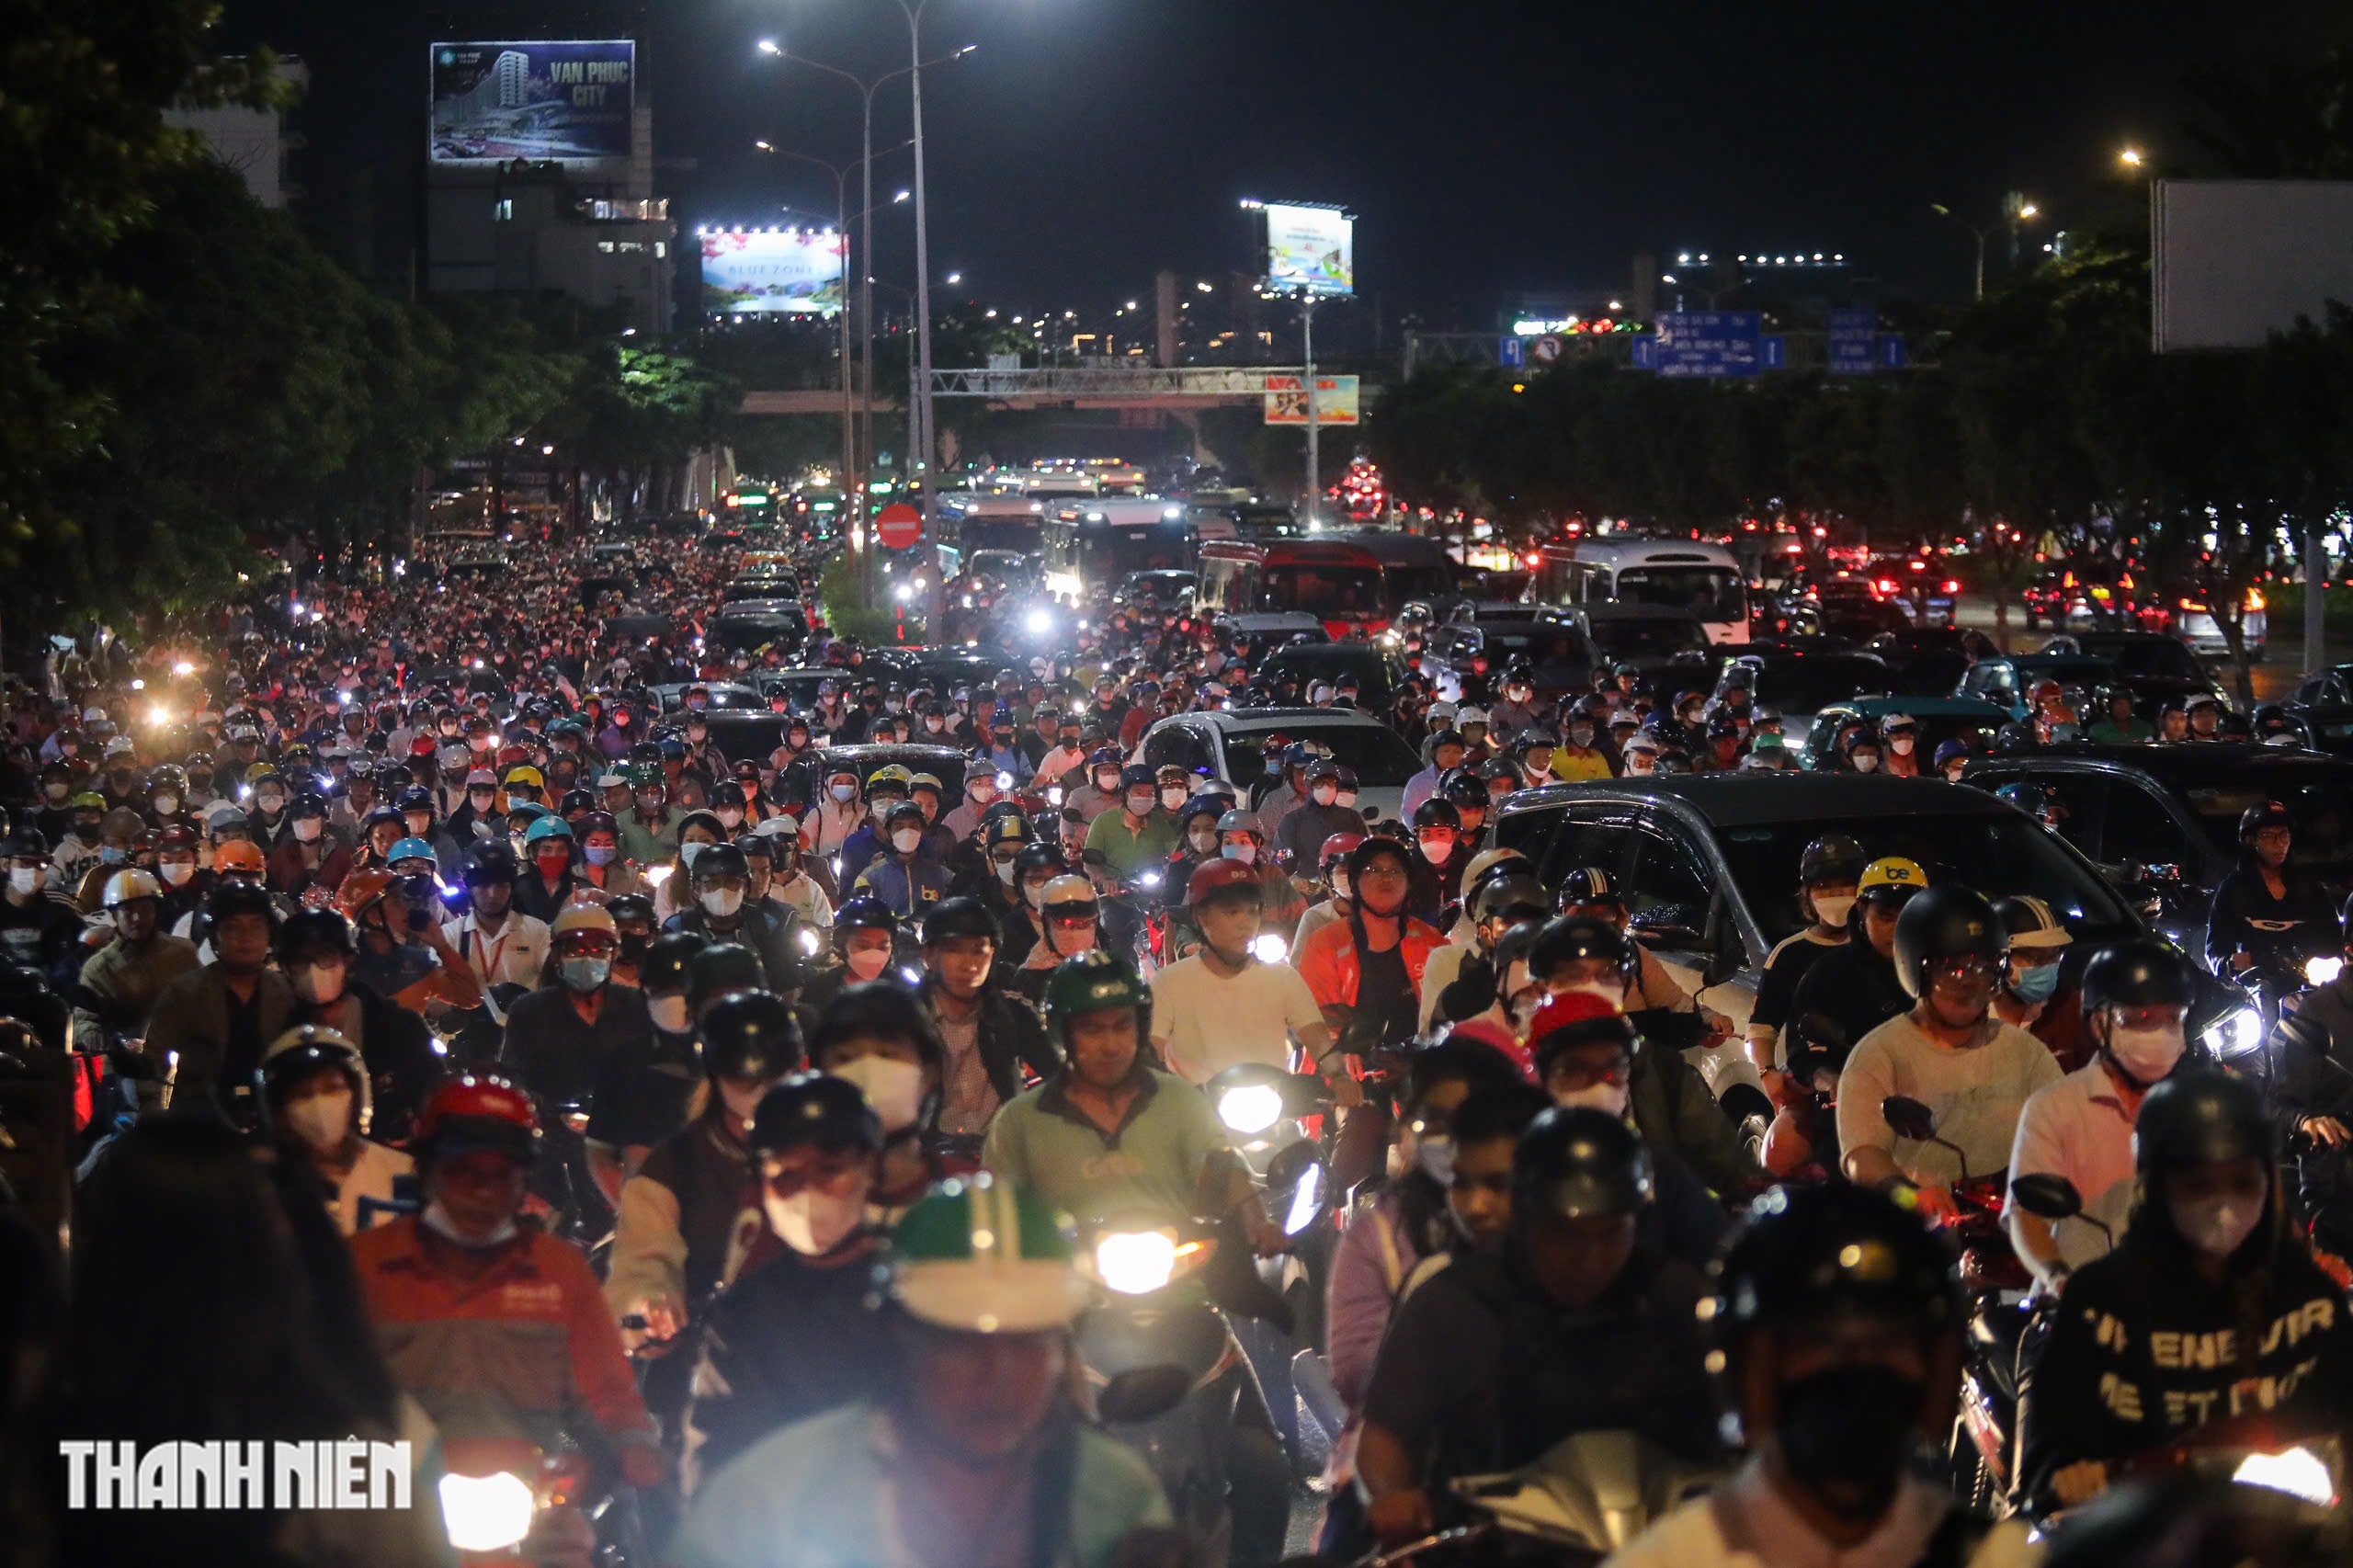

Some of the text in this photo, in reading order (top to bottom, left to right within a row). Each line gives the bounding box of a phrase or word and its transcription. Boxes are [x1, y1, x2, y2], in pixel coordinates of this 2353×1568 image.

[551, 61, 629, 84] VAN PHUC
[572, 85, 608, 107] CITY
[1885, 866, 1910, 880] be
[921, 884, 939, 902] be
